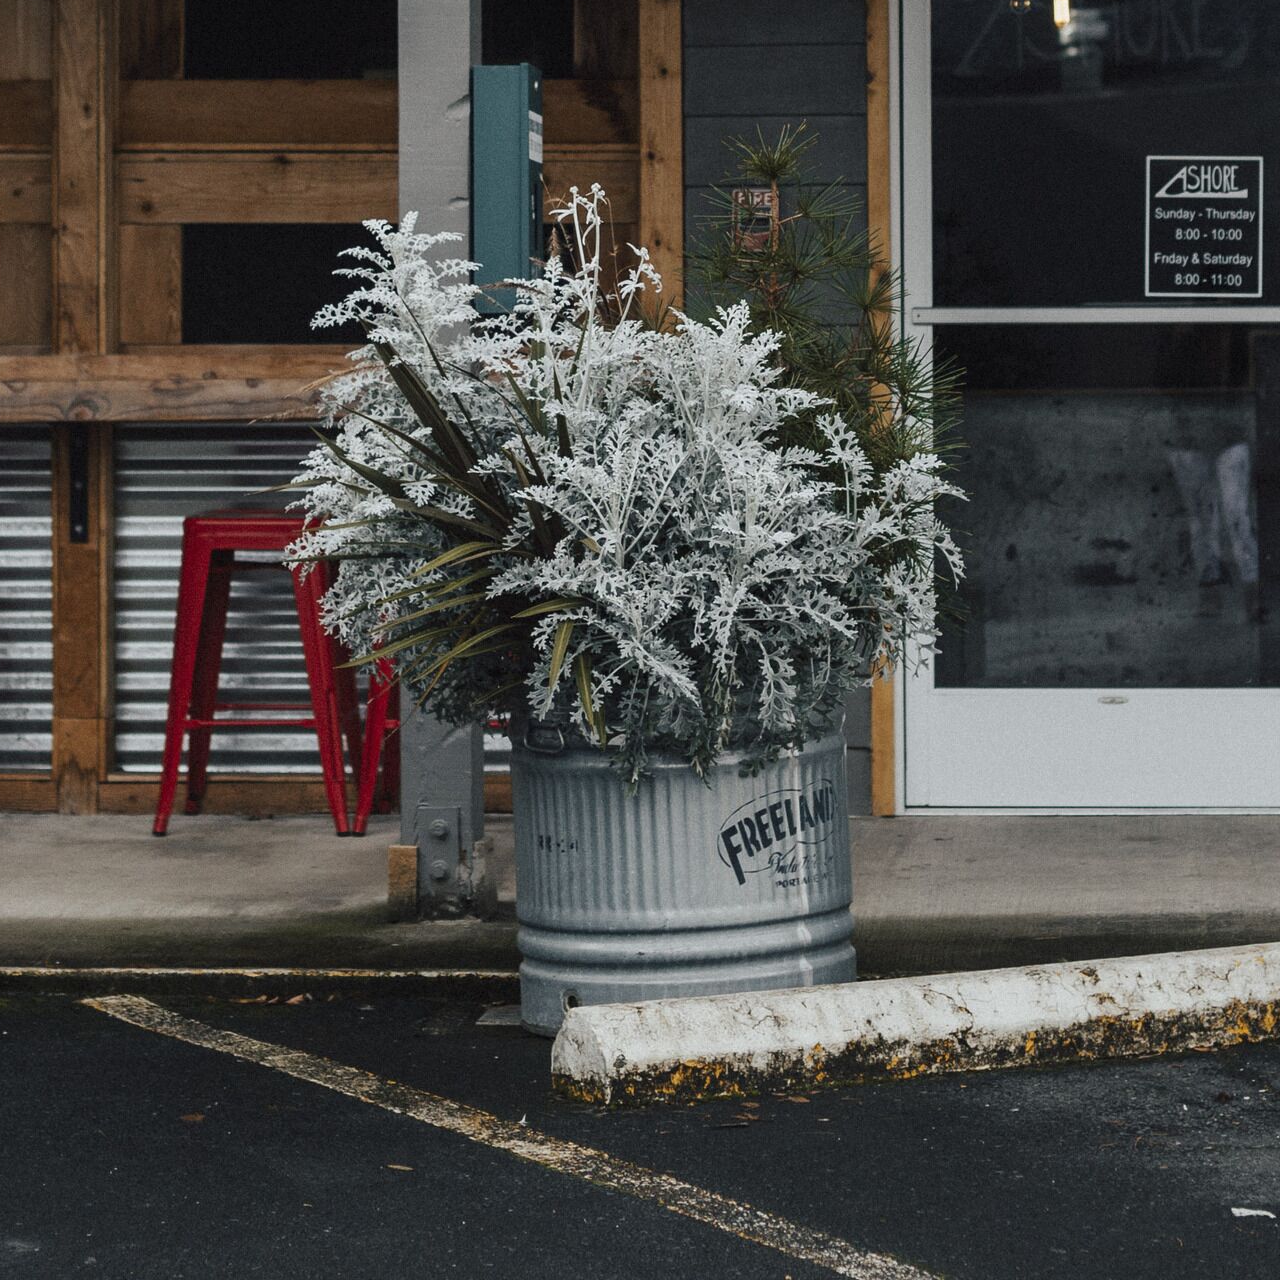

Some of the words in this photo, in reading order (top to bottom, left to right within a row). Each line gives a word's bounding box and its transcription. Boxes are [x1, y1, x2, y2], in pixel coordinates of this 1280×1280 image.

[1154, 164, 1245, 198] ASHORE
[1154, 207, 1196, 222] Sunday
[1205, 207, 1256, 222] Thursday
[1175, 228, 1200, 241] 8:00
[1211, 228, 1243, 241] 10:00
[1153, 252, 1189, 267] Friday
[1191, 253, 1200, 264] &
[1203, 253, 1253, 268] Saturday
[1174, 273, 1200, 286] 8:00
[1211, 274, 1243, 287] 11:00
